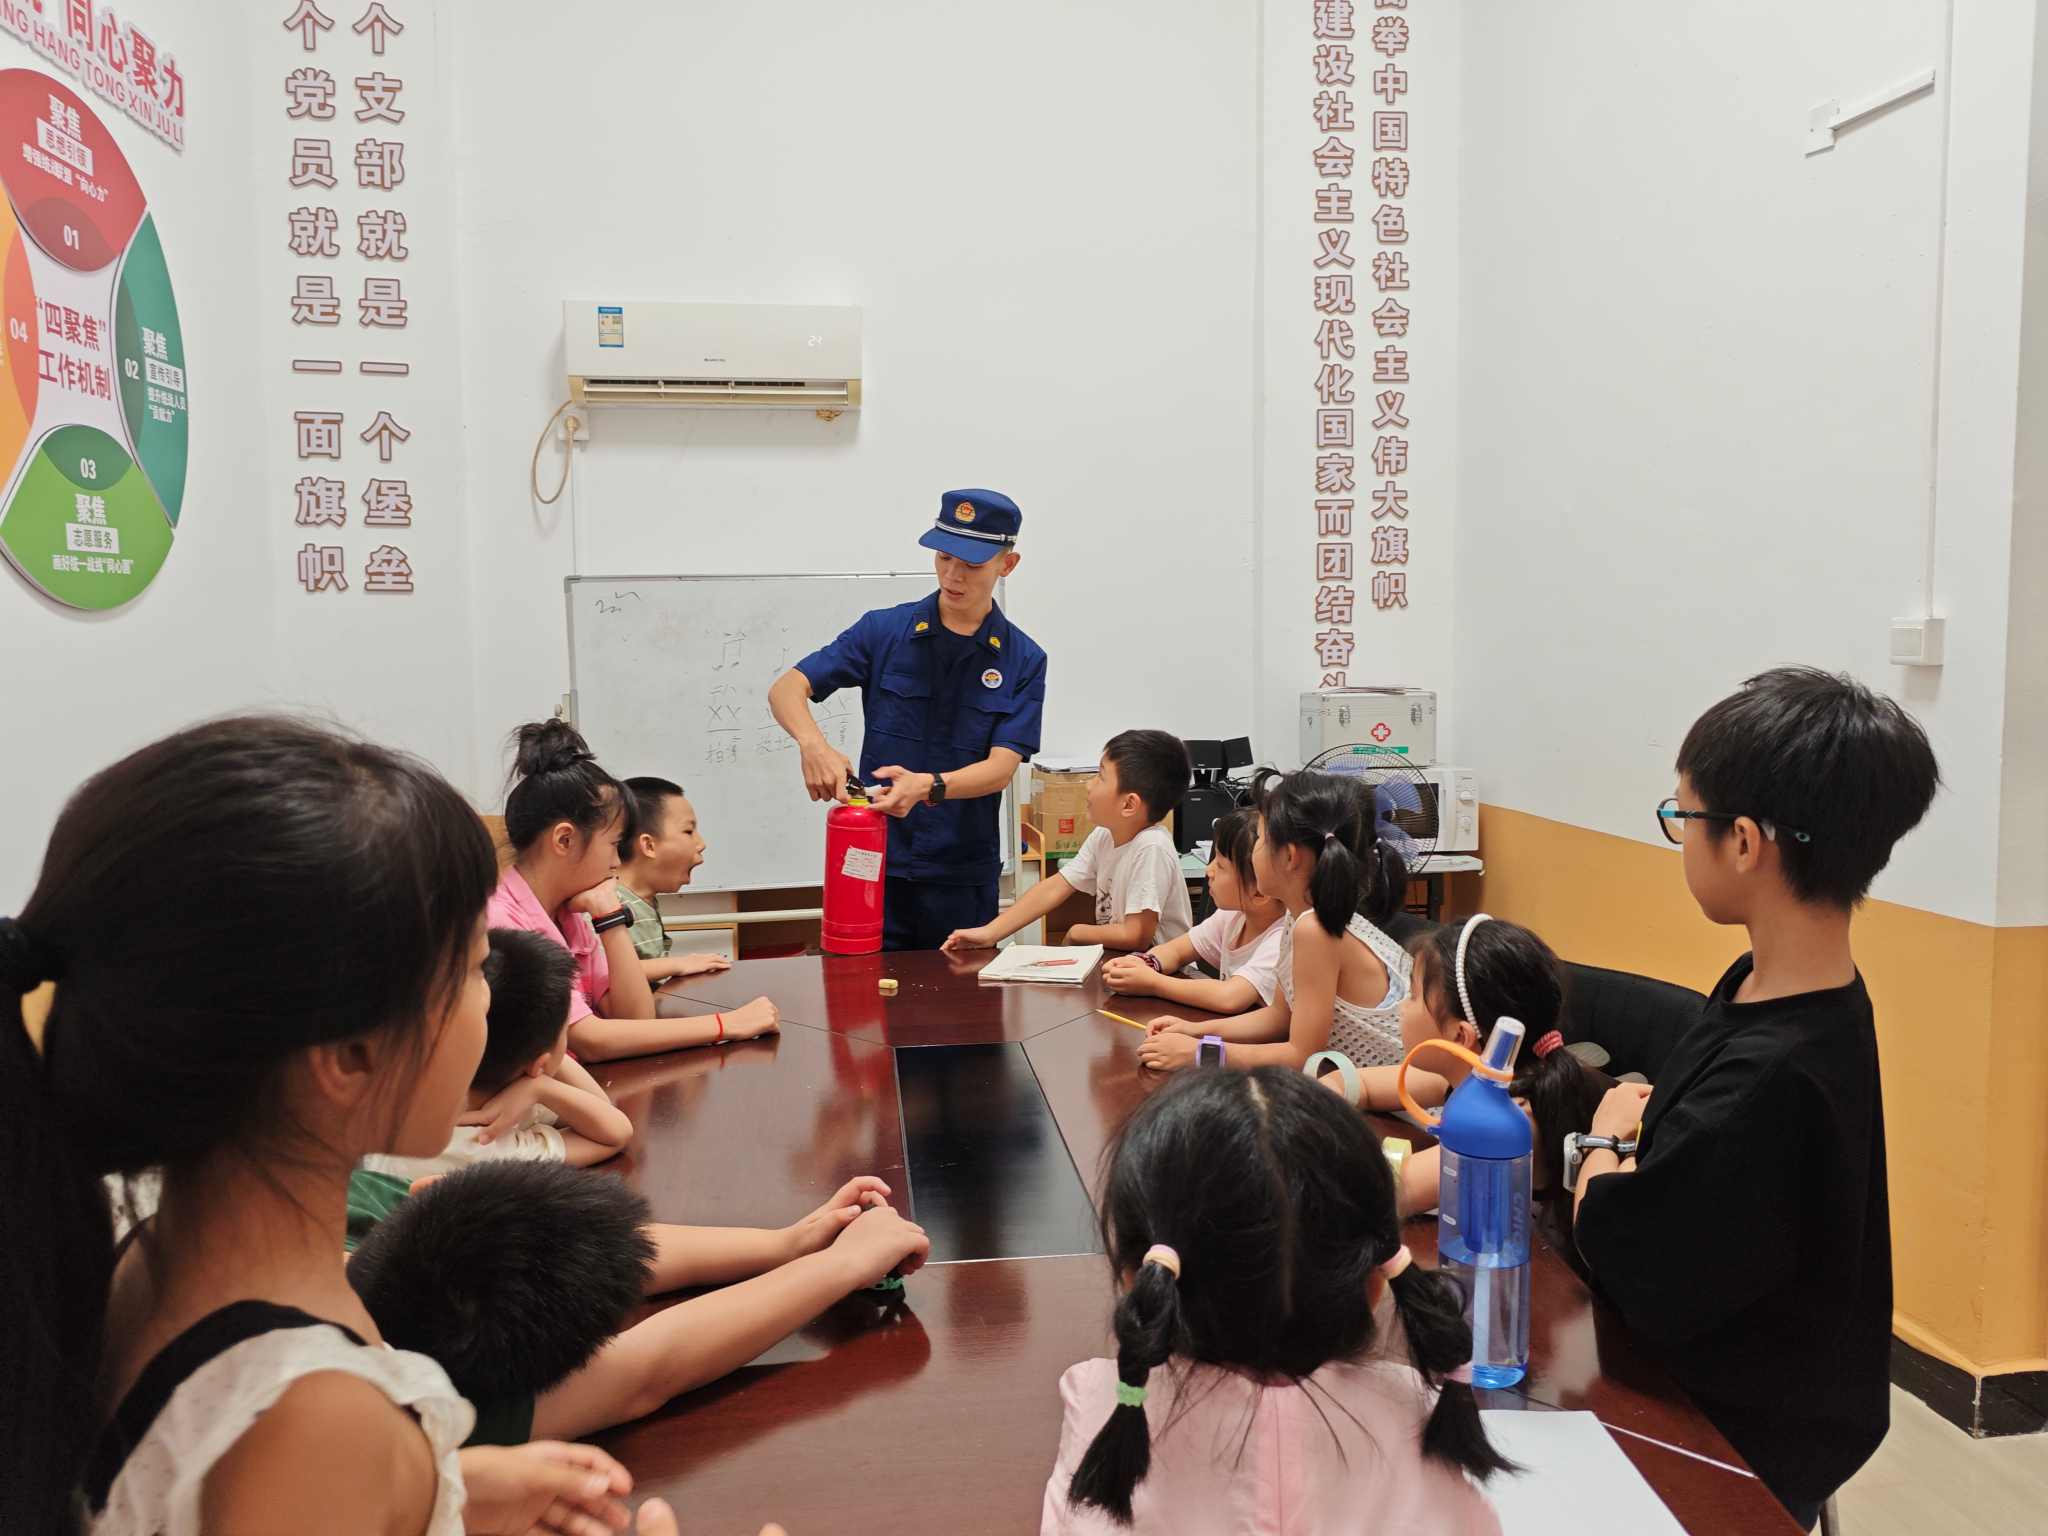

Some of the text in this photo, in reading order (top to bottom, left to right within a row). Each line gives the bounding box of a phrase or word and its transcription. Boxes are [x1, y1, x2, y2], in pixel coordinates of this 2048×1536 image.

[0, 1, 184, 145] NG HANG TONG XIN JU LI
[48, 92, 82, 141] 聚焦
[63, 225, 80, 250] 01
[283, 0, 349, 592] 个党员就是一面旗帜
[352, 2, 414, 593] 个支部就是一个堡垒
[1371, 0, 1410, 609] 举中国特色社会主义伟大旗帜
[10, 317, 28, 343] 04
[36, 296, 106, 352] “四聚焦”
[142, 326, 168, 361] 聚焦
[38, 348, 111, 400] 工作机制
[125, 358, 140, 380] 02
[80, 458, 96, 480] 03
[75, 493, 106, 526] 聚焦
